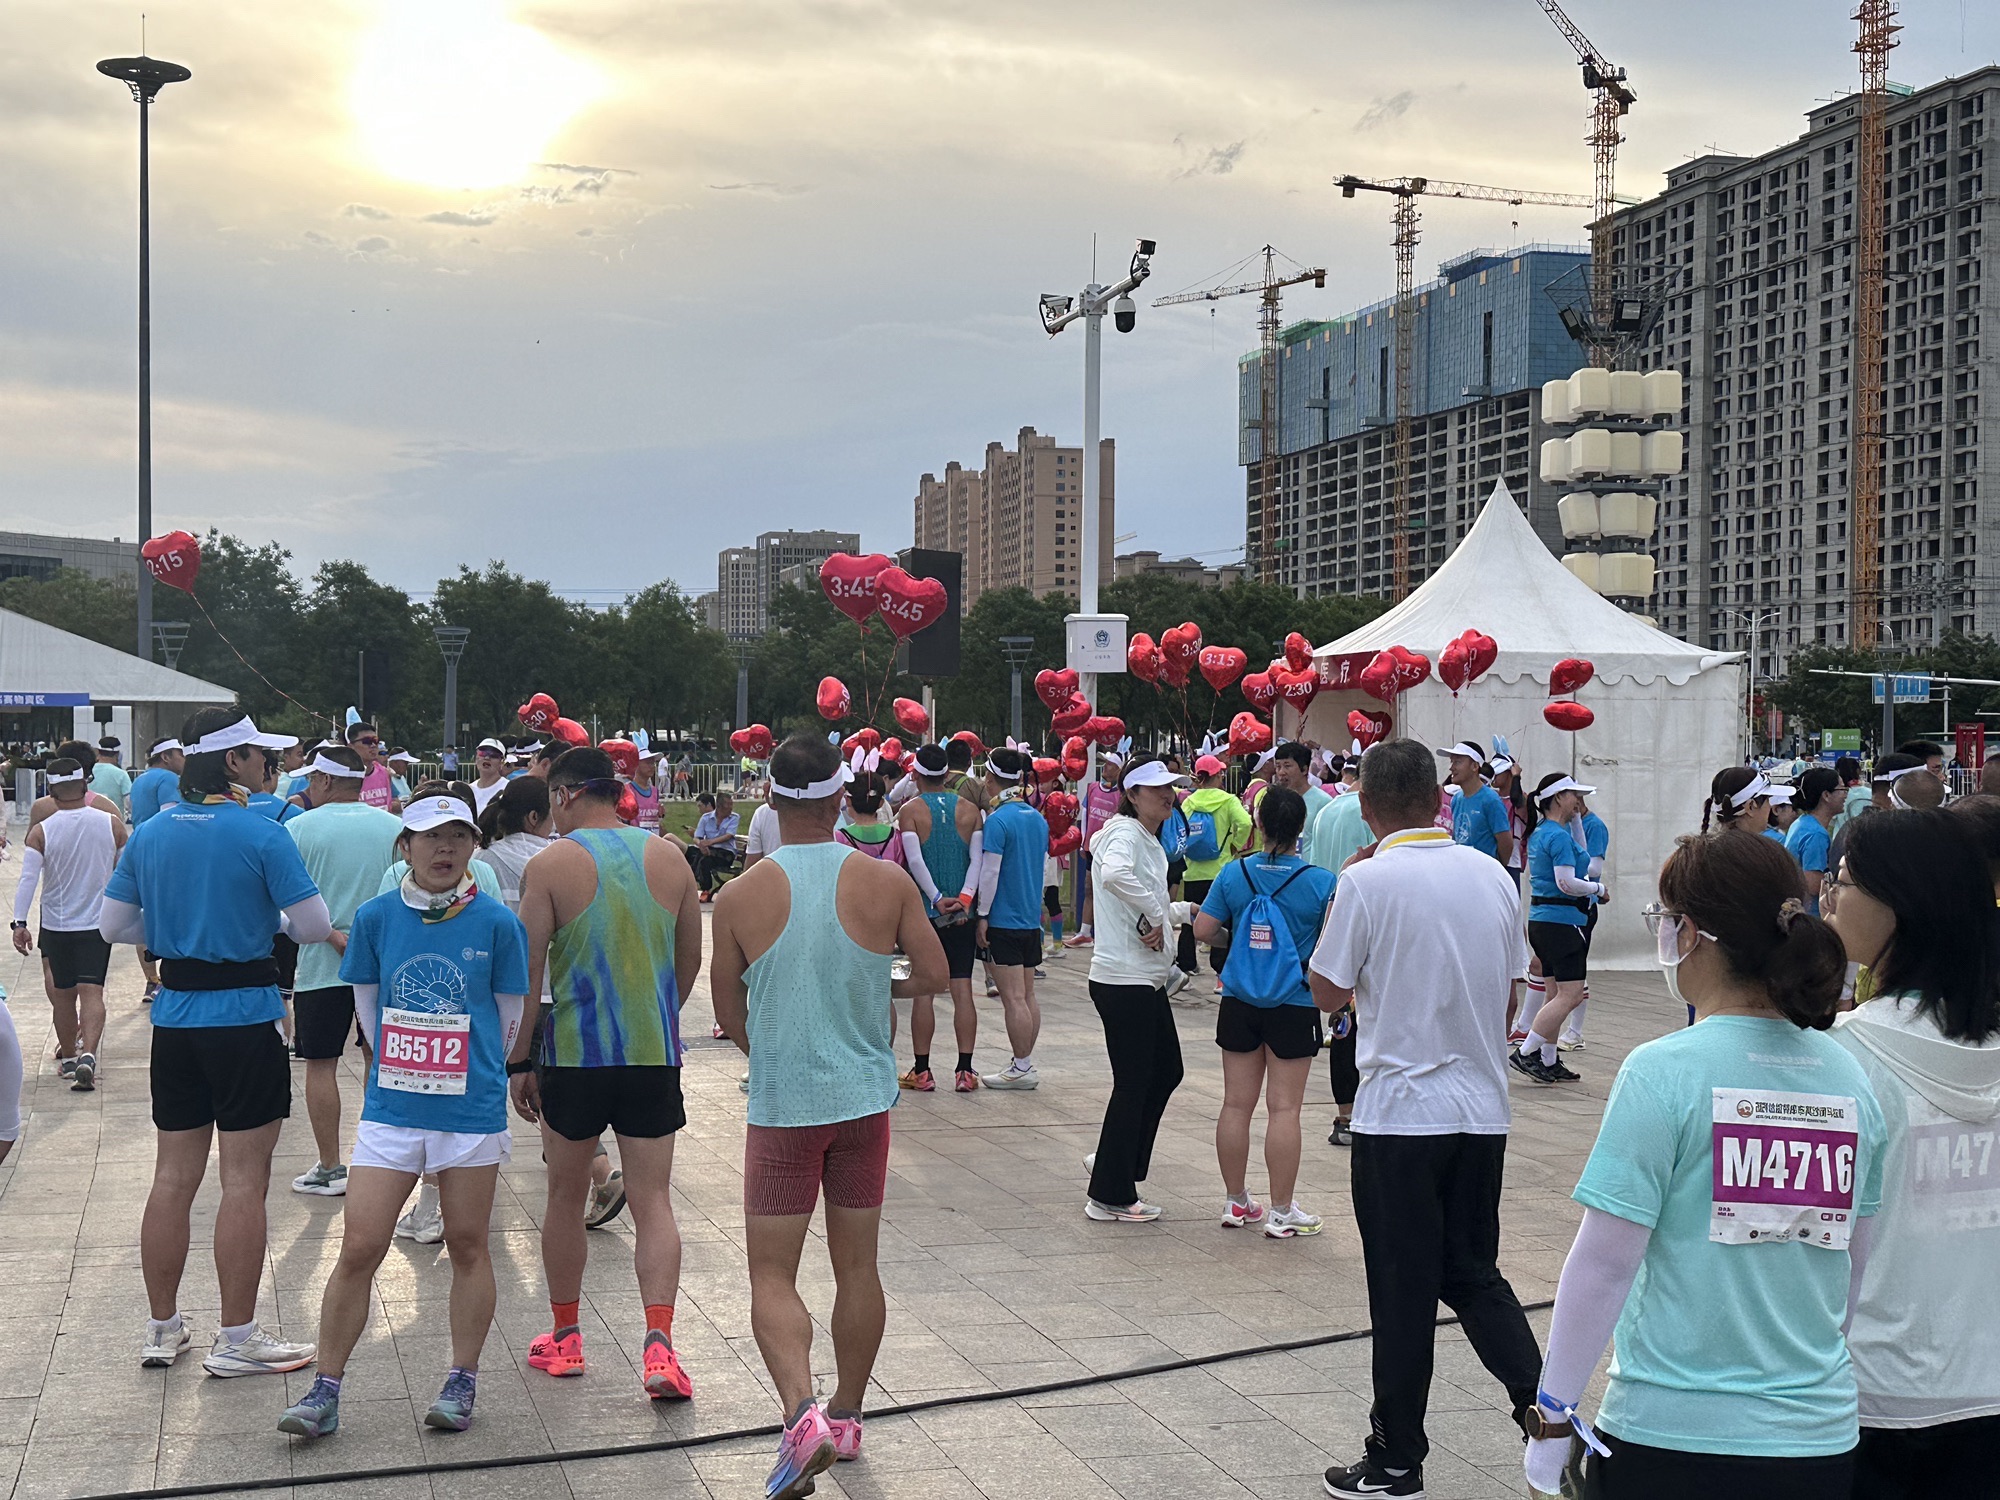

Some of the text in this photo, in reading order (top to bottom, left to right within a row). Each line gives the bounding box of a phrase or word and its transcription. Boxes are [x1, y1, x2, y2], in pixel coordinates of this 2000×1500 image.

[146, 549, 184, 576] 2:15
[830, 576, 876, 598] 3:45
[880, 592, 925, 622] 3:45
[1204, 652, 1237, 667] 3:15
[1283, 682, 1313, 698] 2:30
[1232, 718, 1259, 742] 3:15
[1353, 718, 1383, 734] 2:00
[1825, 732, 1833, 748] B
[385, 1031, 462, 1065] B5512
[1722, 1136, 1854, 1195] M4716
[1915, 1131, 2000, 1181] M47
